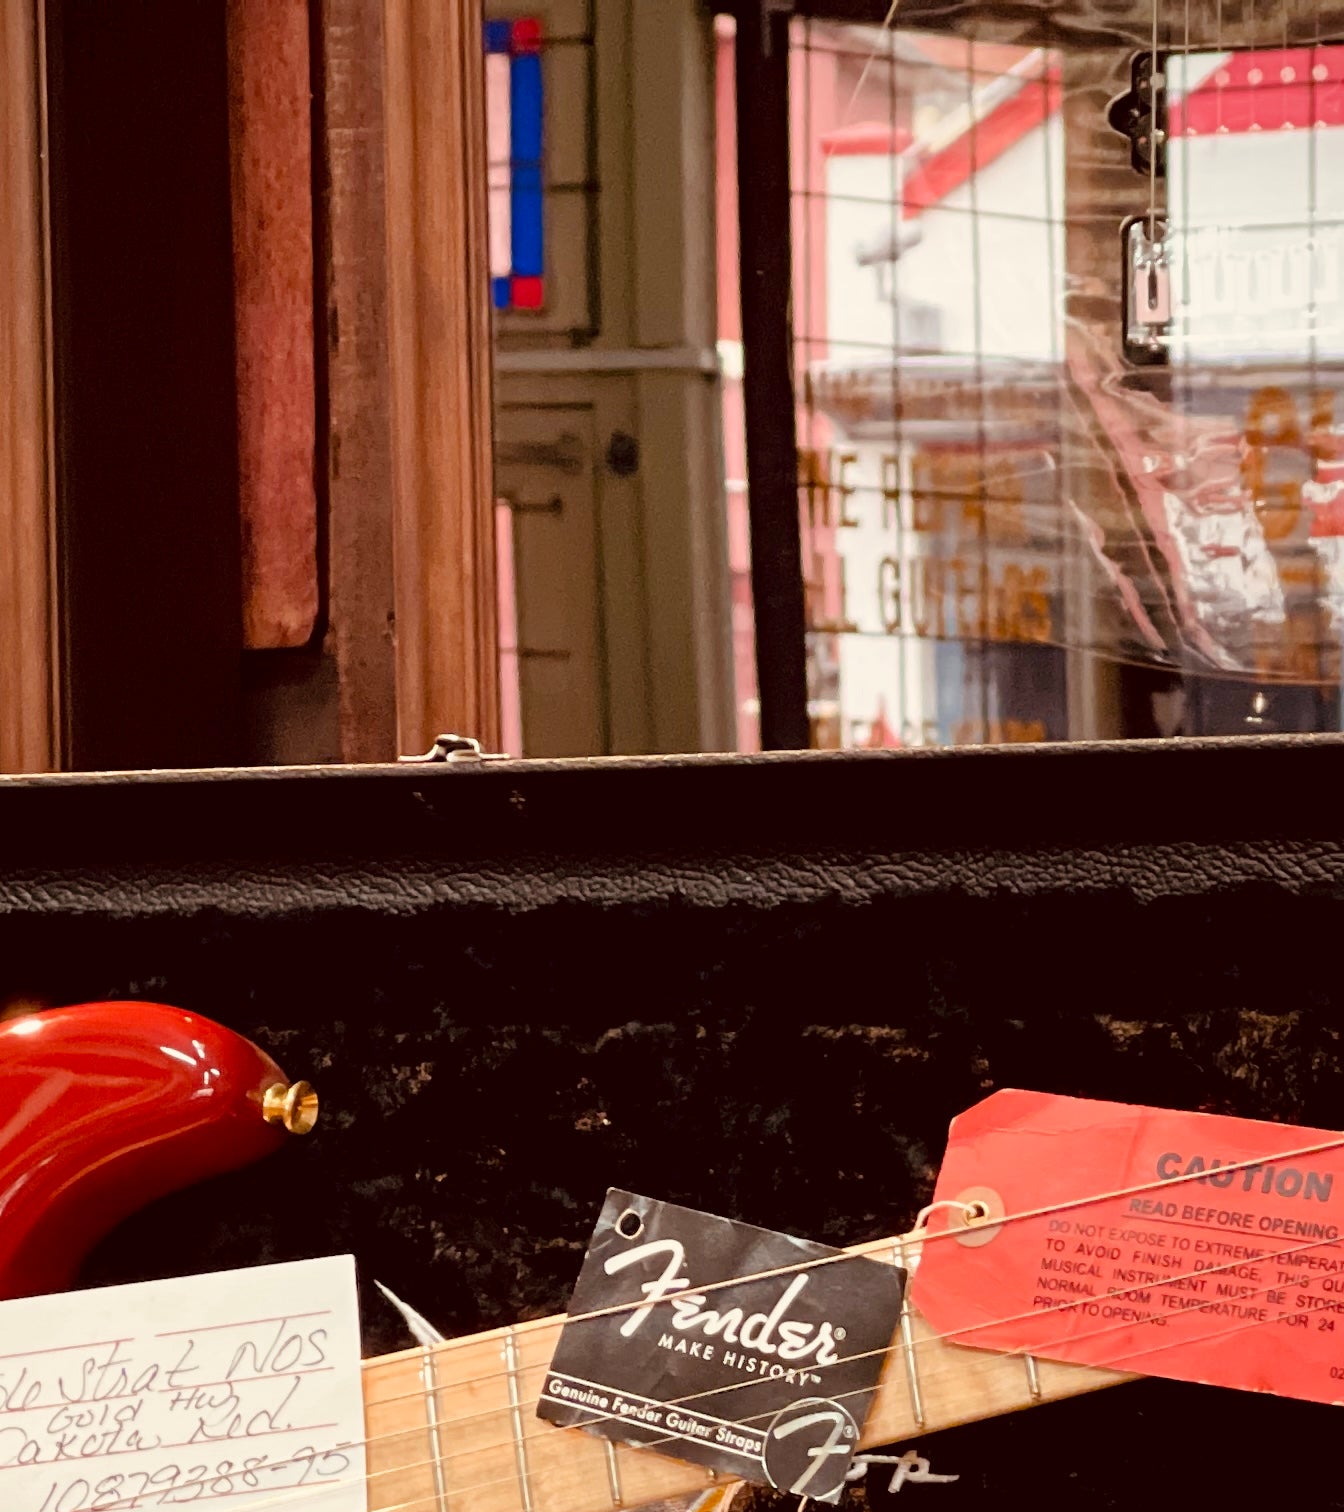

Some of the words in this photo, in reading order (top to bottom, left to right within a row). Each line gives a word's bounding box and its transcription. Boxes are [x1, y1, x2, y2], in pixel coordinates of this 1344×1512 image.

[1156, 1152, 1333, 1202] CAUTION
[1048, 1219, 1071, 1234] DO
[1074, 1222, 1105, 1238] NOT
[1108, 1227, 1166, 1248] EXPOSE
[1171, 1236, 1191, 1251] TO
[1194, 1239, 1264, 1262] EXTREME
[1129, 1198, 1177, 1217] READ
[1182, 1205, 1255, 1229] BEFORE
[1258, 1216, 1338, 1240] OPENING
[1040, 1257, 1103, 1278] MUSICAL
[1112, 1268, 1207, 1293] INSTRUMENT
[1216, 1283, 1259, 1300] MUST
[1266, 1289, 1287, 1305] BE
[1045, 1238, 1066, 1253] TO
[1075, 1243, 1121, 1261] AVOID
[1132, 1250, 1182, 1269] FINISH
[1276, 1271, 1310, 1289] THIS
[604, 1239, 840, 1366] Fender
[1033, 1295, 1077, 1314] PRIOR
[1081, 1302, 1100, 1317] TO
[1036, 1276, 1096, 1297] NORMAL
[1107, 1286, 1152, 1304] ROOM
[1161, 1294, 1268, 1321] TEMPERATURE
[1276, 1311, 1309, 1329] FOR
[1318, 1318, 1335, 1332] 24
[658, 1333, 715, 1361] MAKE
[723, 1350, 810, 1386] HISTORY
[548, 1379, 609, 1409] Genuine
[612, 1396, 663, 1424] Fender
[666, 1412, 711, 1438] Guitar
[715, 1427, 762, 1454] Straps
